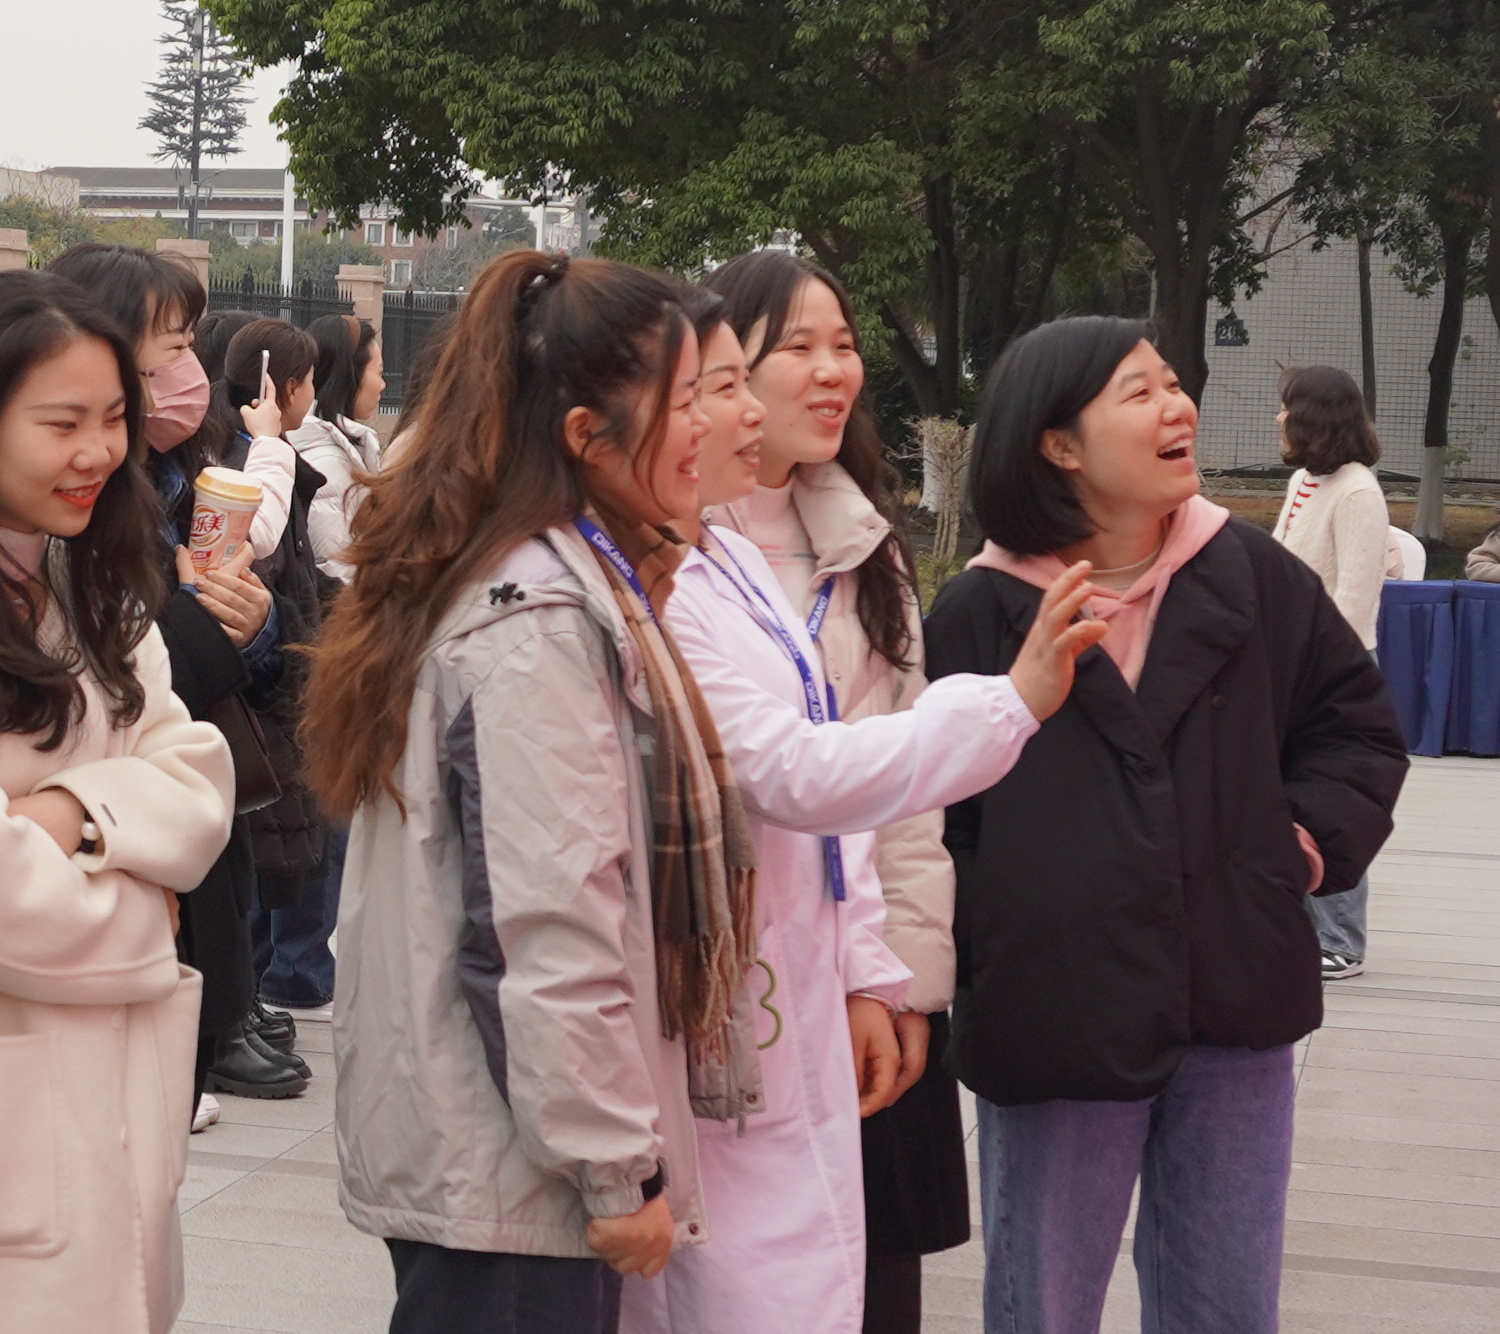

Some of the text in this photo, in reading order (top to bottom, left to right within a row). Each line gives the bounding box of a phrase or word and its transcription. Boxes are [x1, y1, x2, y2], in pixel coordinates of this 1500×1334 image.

[190, 513, 226, 533] 乐美
[591, 531, 634, 579] DIKANG
[805, 680, 825, 725] DIKAN
